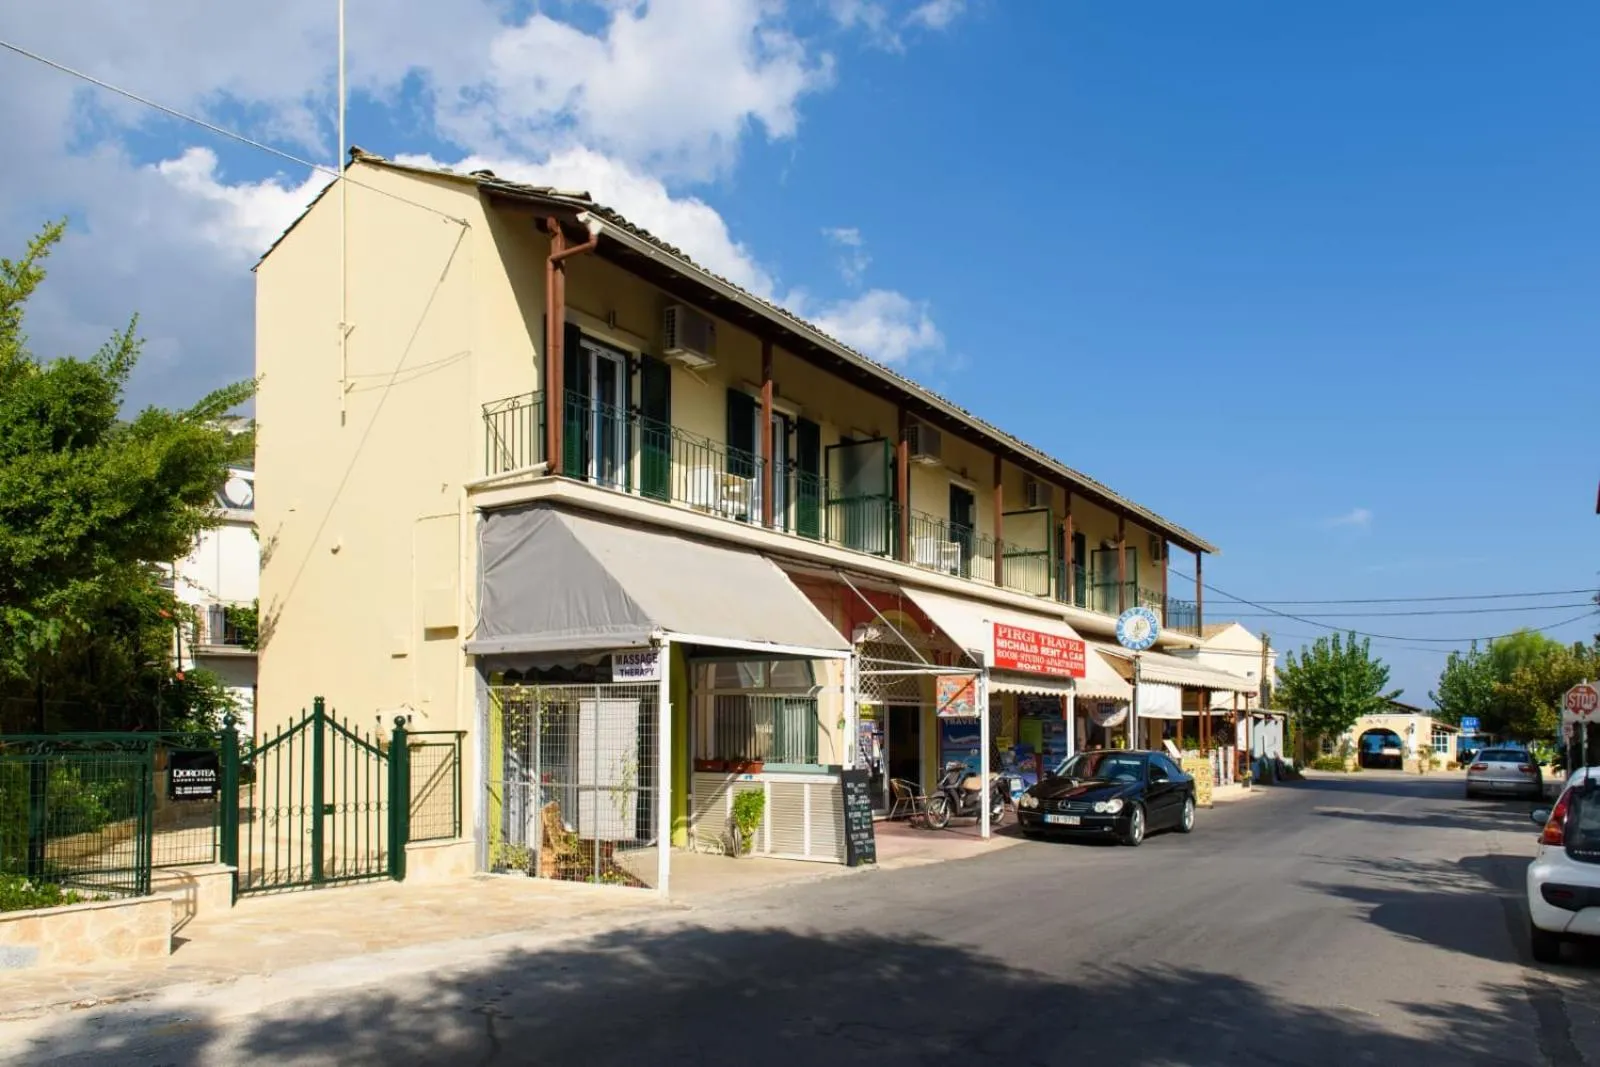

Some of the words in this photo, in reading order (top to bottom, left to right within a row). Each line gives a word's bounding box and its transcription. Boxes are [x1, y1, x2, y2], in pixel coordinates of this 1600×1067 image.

[997, 626, 1034, 642] PIRGI
[1039, 634, 1082, 652] TRAVEL
[996, 637, 1038, 653] MICHALIS
[1040, 646, 1060, 657] RENT
[1062, 650, 1067, 658] A
[1068, 651, 1083, 661] CAR
[615, 652, 658, 665] MASSAGE
[619, 668, 654, 677] THERAPY
[1568, 693, 1596, 709] STOP
[173, 769, 216, 777] DOROTEA
